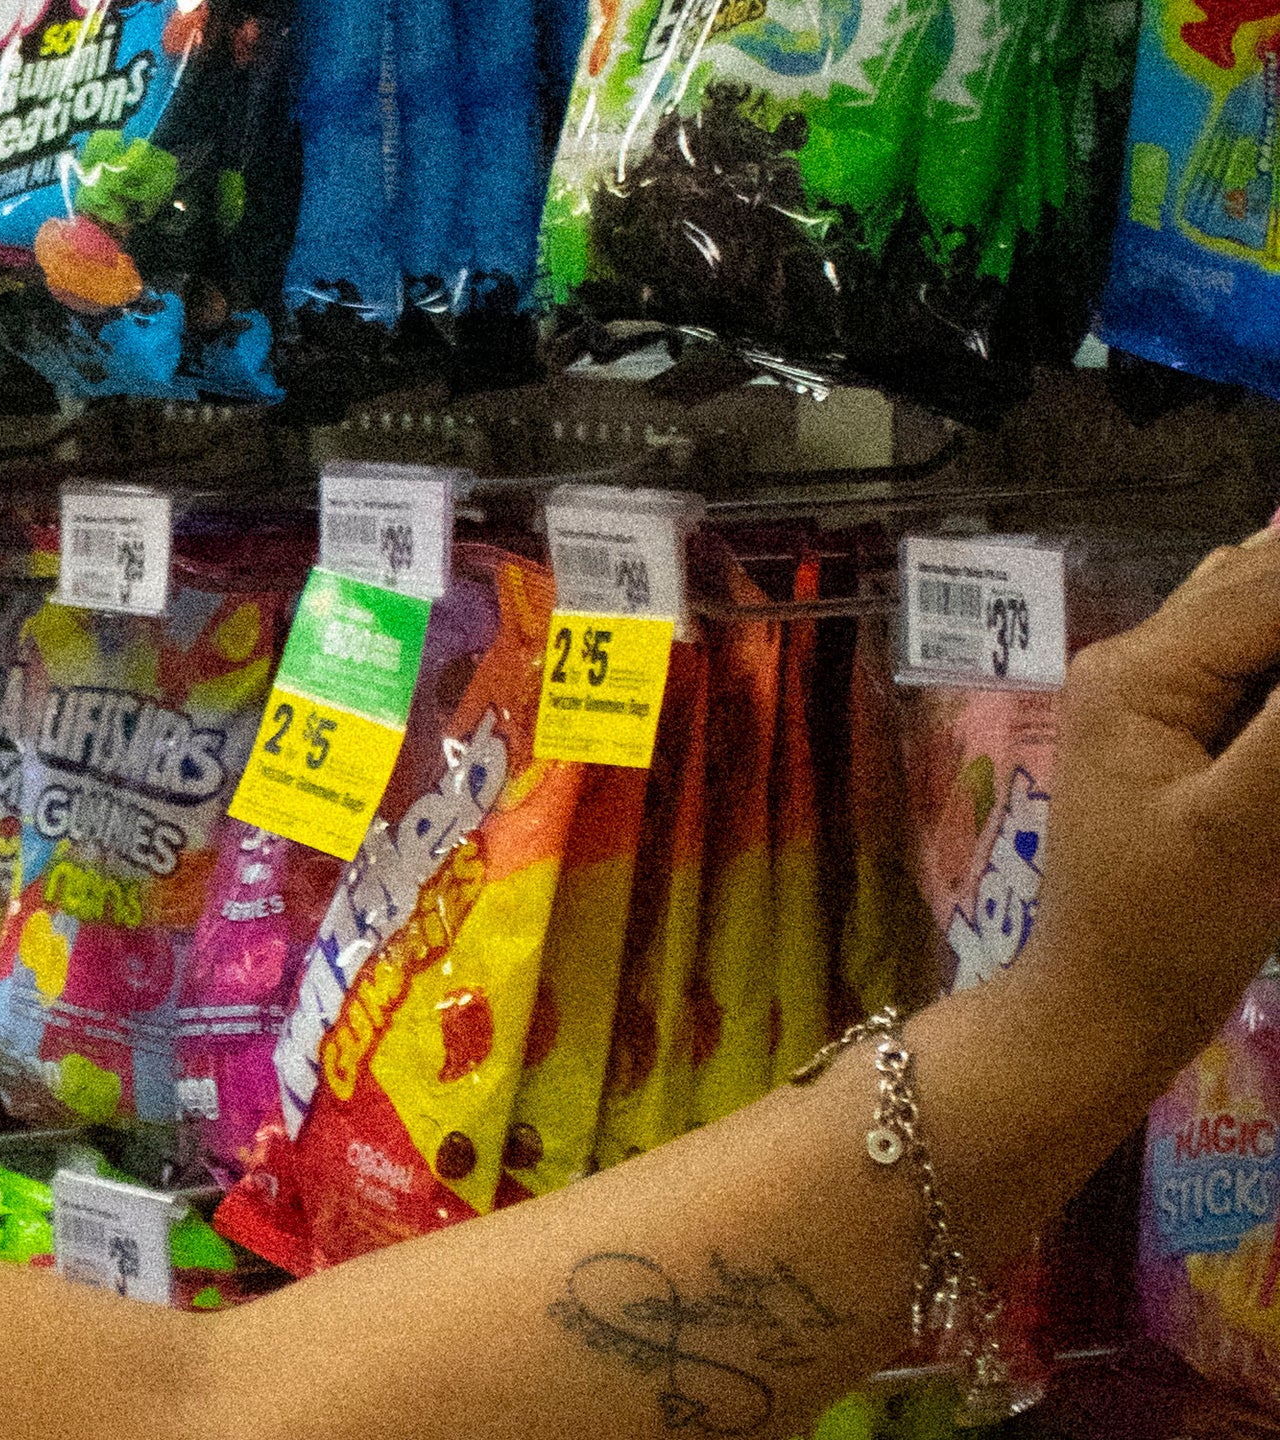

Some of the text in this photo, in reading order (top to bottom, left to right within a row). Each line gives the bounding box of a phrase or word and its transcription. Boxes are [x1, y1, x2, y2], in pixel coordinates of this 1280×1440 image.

[551, 628, 612, 686] 2 $5
[264, 704, 336, 769] 2 $5
[37, 784, 185, 876] GUMMIES
[1175, 1113, 1274, 1159] MAGIC
[1159, 1167, 1278, 1229] STICKS
